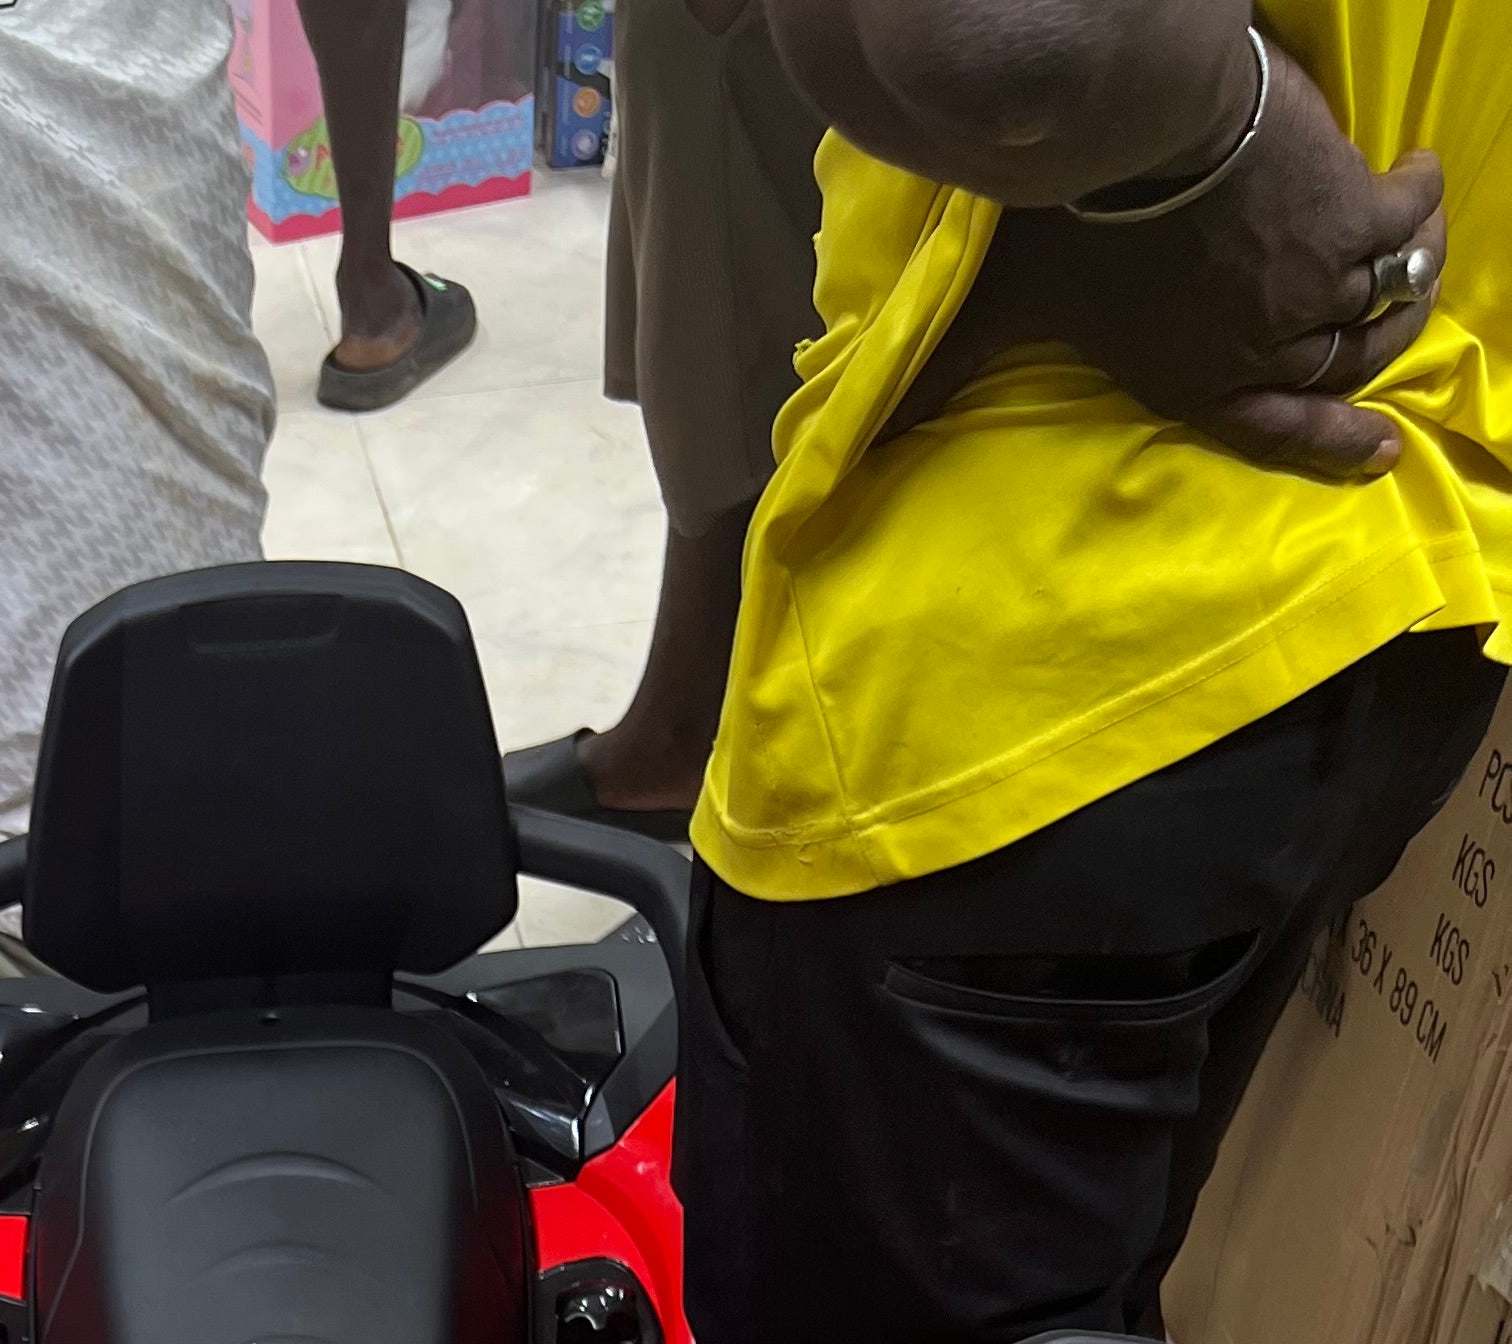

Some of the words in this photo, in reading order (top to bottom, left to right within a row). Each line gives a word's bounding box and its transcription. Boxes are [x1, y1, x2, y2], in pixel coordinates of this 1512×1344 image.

[1451, 833, 1494, 907] KGS
[1429, 912, 1469, 986] KGS
[1351, 918, 1377, 977] 36
[1372, 943, 1392, 996] X
[1390, 967, 1418, 1026] 89
[1415, 999, 1447, 1065] CM
